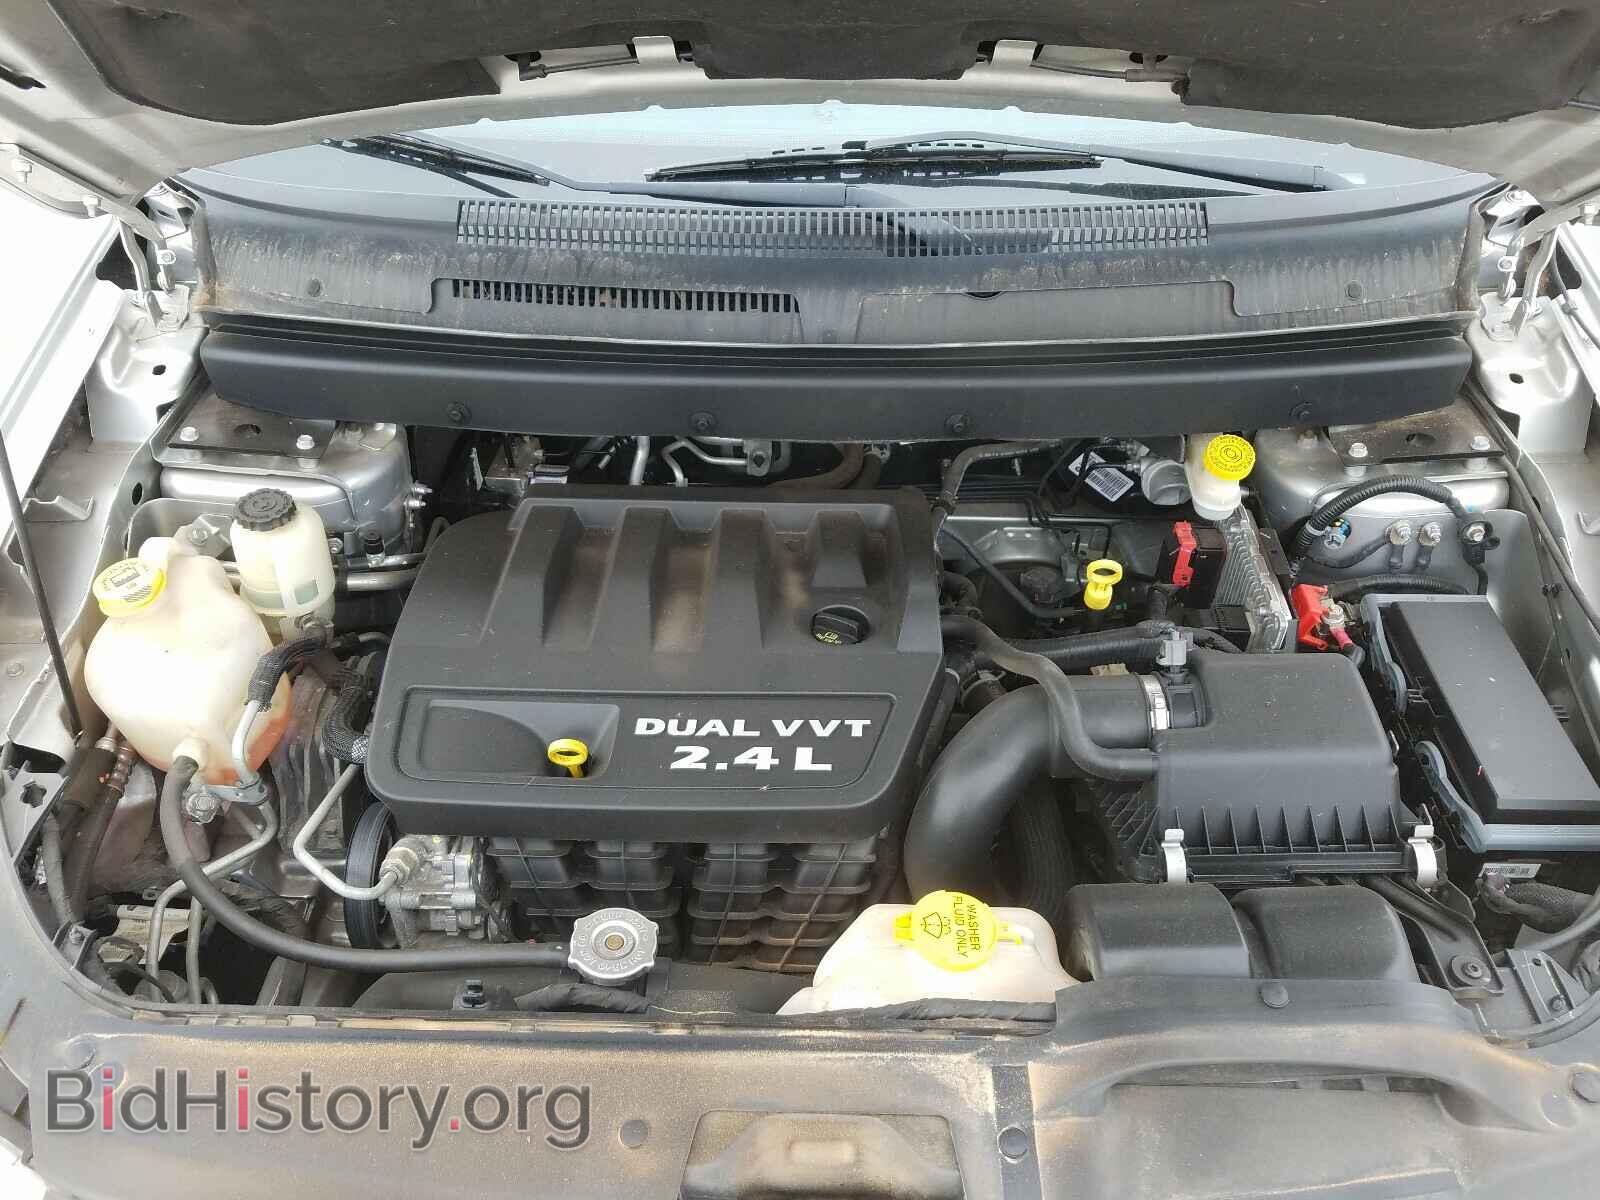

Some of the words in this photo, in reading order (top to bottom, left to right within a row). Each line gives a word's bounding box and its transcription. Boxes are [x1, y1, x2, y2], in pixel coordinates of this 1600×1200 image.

[634, 717, 761, 737] DUAL
[771, 719, 872, 737] VVT
[670, 745, 780, 770] 2.4
[794, 746, 833, 771] L
[953, 895, 965, 926] FLUID
[966, 904, 981, 952] WASHER
[955, 929, 969, 958] ONLY
